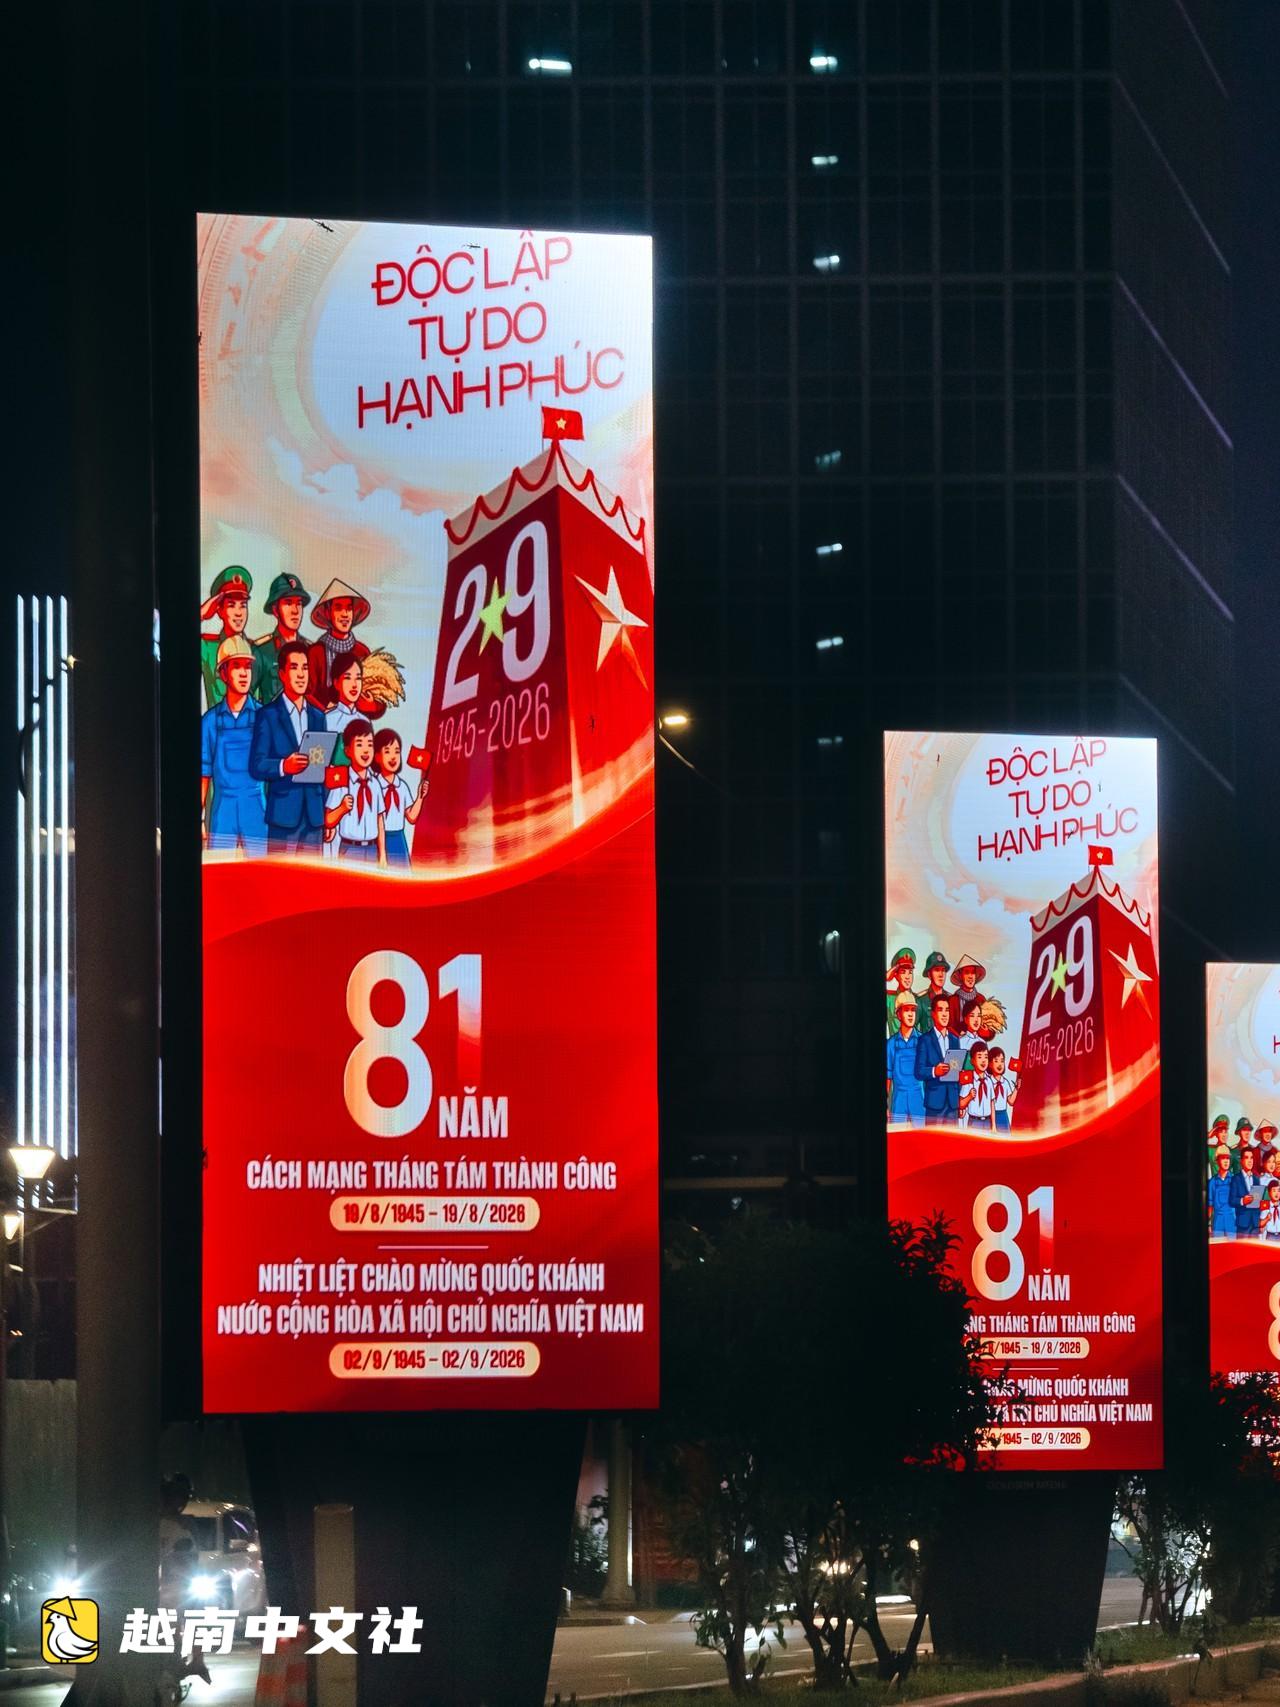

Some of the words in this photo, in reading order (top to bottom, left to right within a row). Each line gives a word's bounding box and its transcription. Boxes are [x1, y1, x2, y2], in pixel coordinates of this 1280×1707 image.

[371, 245, 475, 306] ĐỘC
[483, 230, 572, 292] LẬP
[408, 308, 476, 363] TỰ
[483, 302, 547, 351] DO
[358, 366, 490, 429] HẠNH
[499, 340, 625, 407] PHÚC
[986, 746, 1048, 786] ĐỘC
[1053, 735, 1107, 774] LẬP
[1008, 785, 1049, 820] TỰ
[1053, 780, 1091, 811] DO
[978, 821, 1057, 861] HẠNH
[1063, 803, 1138, 845] PHÚC
[344, 949, 482, 1138] 81
[439, 1086, 508, 1138] NĂM
[246, 1154, 301, 1189] CÁCH
[307, 1160, 367, 1195] MẠNG
[373, 1154, 438, 1189] THÁNG
[444, 1155, 487, 1189] TÁM
[493, 1156, 558, 1189] THÀNH
[563, 1155, 617, 1190] CÔNG
[971, 1184, 1054, 1300] 81
[1028, 1268, 1070, 1301] NĂM
[258, 1257, 315, 1298] NHIỆT
[318, 1257, 358, 1298] LIỆT
[361, 1257, 415, 1292] CHÀO
[420, 1257, 477, 1292] MỪNG
[481, 1255, 534, 1296] QUỐC
[538, 1256, 605, 1292] KHÁNH
[217, 1299, 272, 1335] NƯỚC
[276, 1299, 329, 1340] CỘNG
[334, 1299, 375, 1333] HÒA
[379, 1299, 405, 1333] XÃ
[410, 1298, 442, 1338] HỘI
[447, 1297, 487, 1333] CHỦ
[492, 1298, 551, 1333] NGHĨA
[555, 1298, 596, 1338] VIỆT
[600, 1303, 644, 1332] NAM
[989, 1311, 1028, 1333] THÁNG
[1032, 1312, 1057, 1333] TÁM
[1061, 1312, 1100, 1333] THÀNH
[1103, 1311, 1136, 1333] CÔNG
[1054, 1374, 1086, 1399] QUỐC
[1088, 1375, 1129, 1397] KHÁNH
[1034, 1400, 1058, 1422] CHỦ
[1061, 1401, 1096, 1422] NGHĨA
[1099, 1400, 1124, 1425] VIỆT
[1125, 1404, 1152, 1422] NAM
